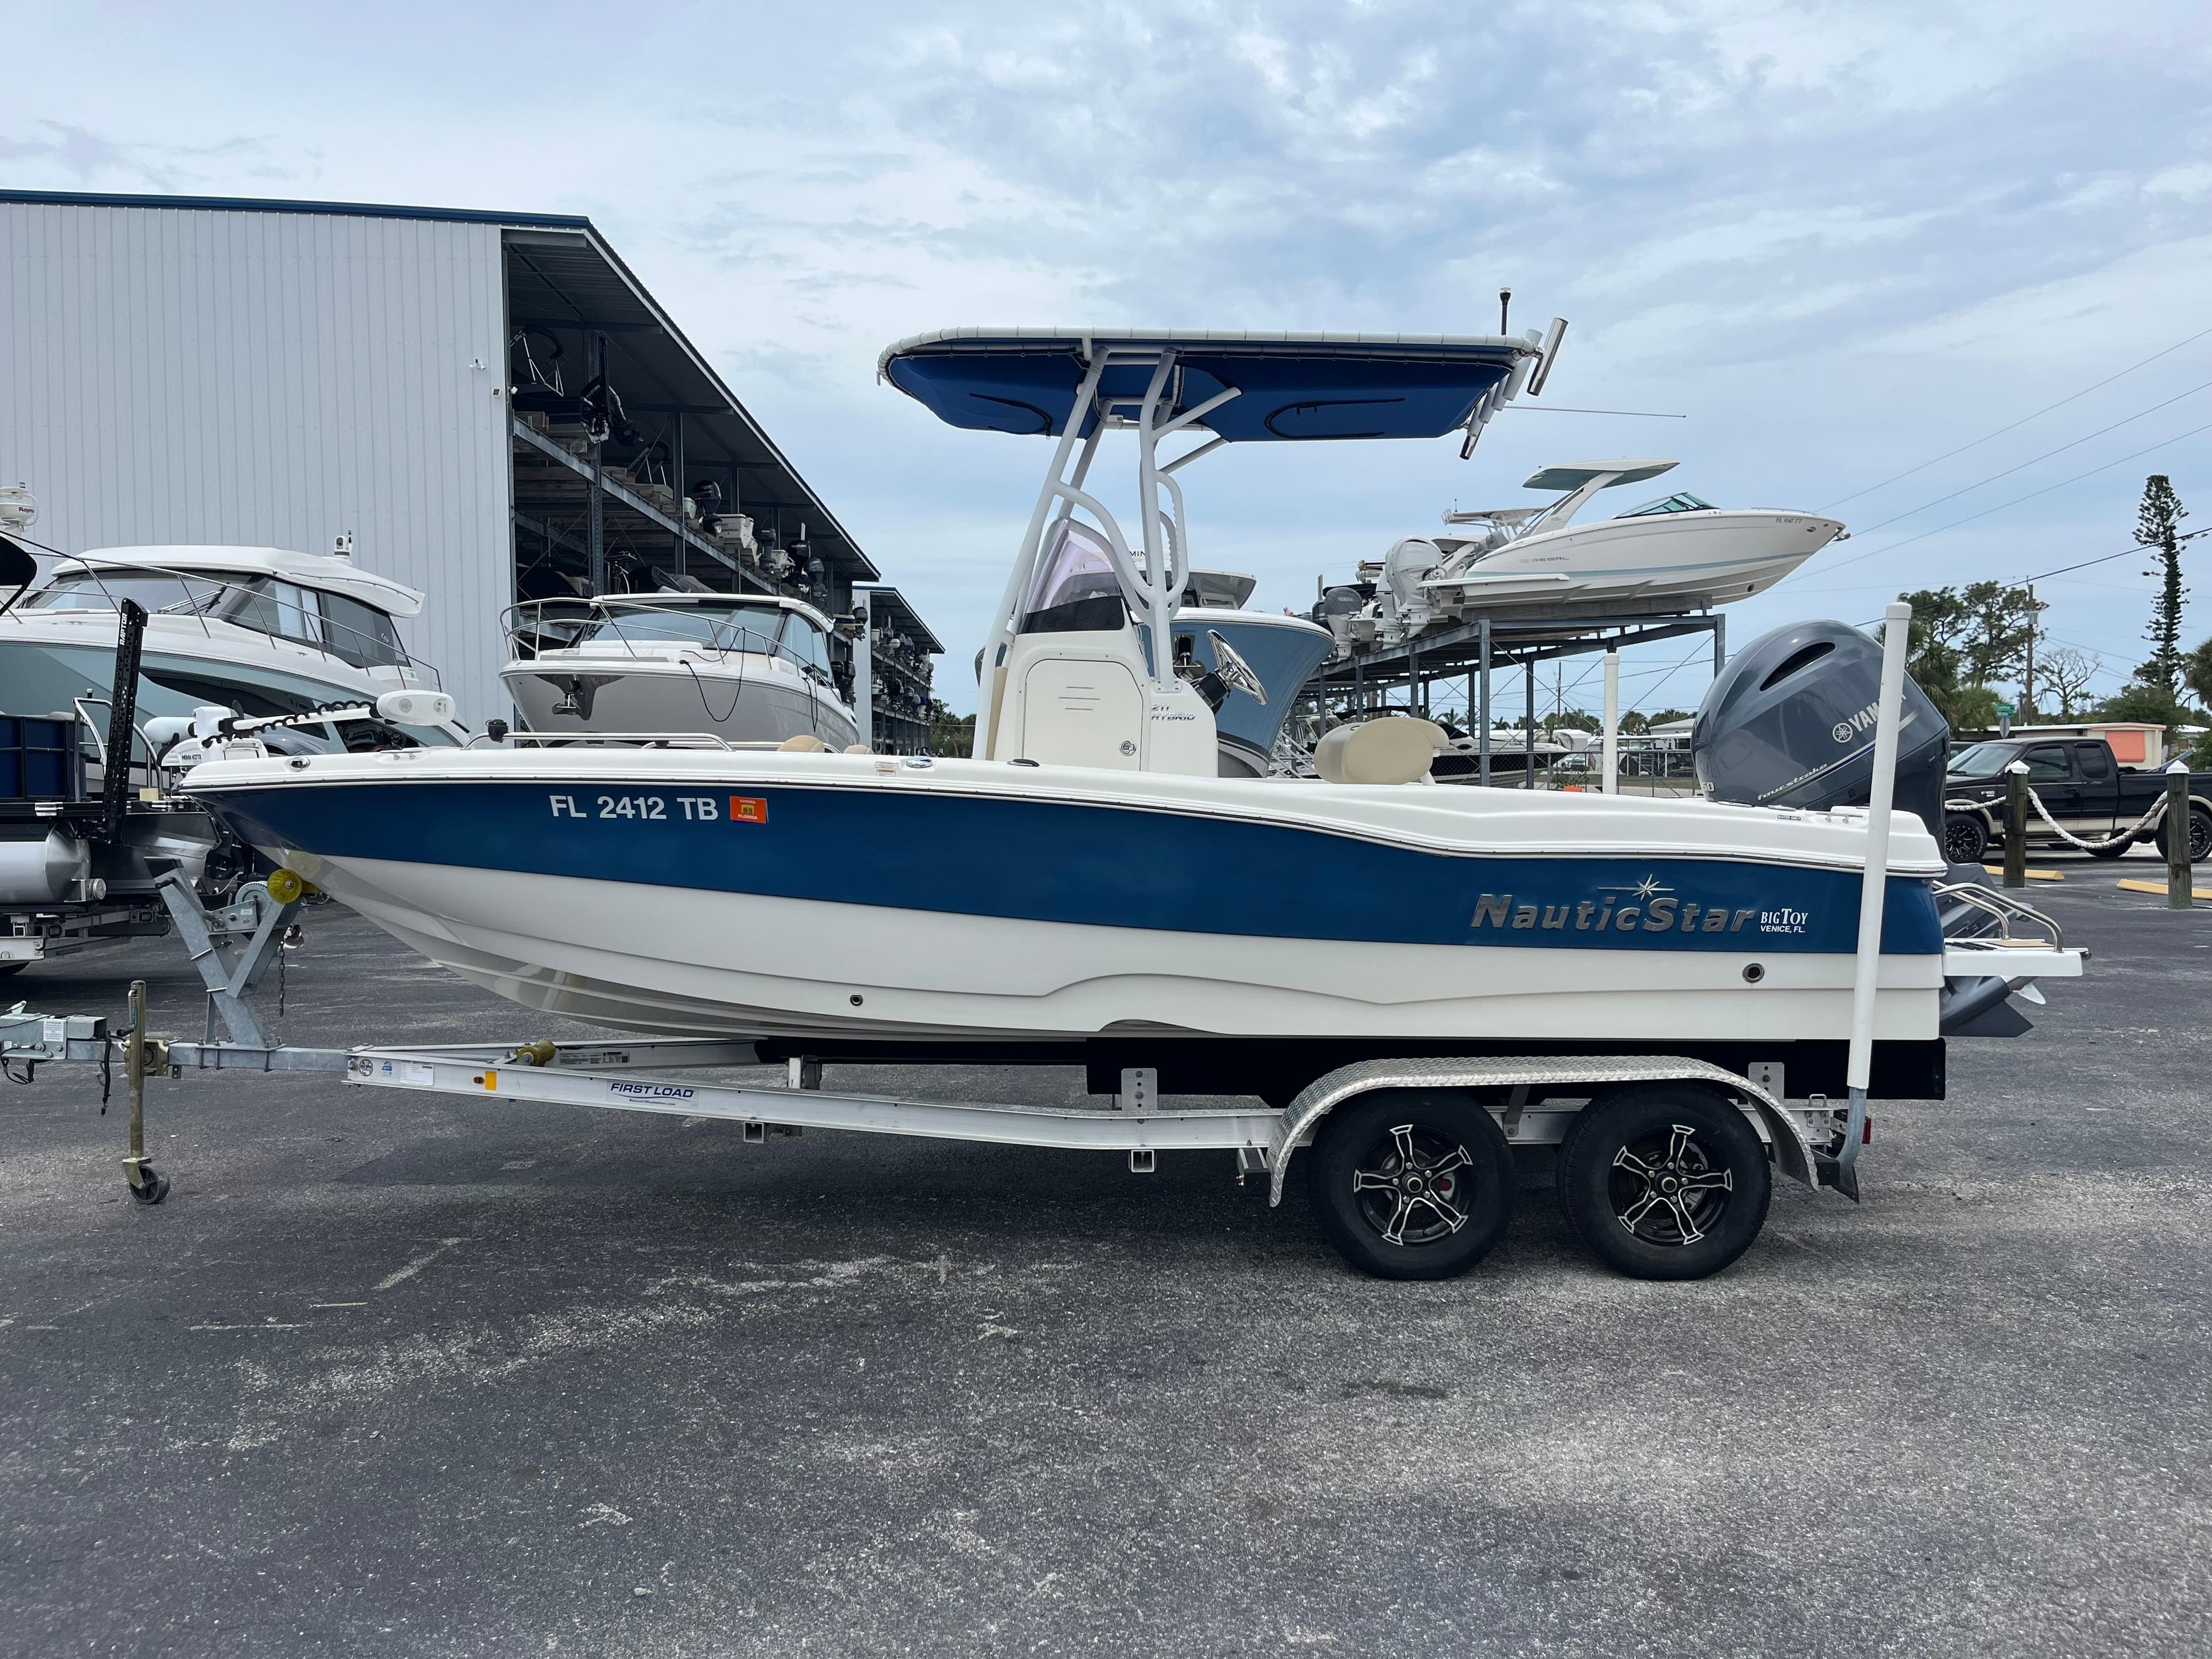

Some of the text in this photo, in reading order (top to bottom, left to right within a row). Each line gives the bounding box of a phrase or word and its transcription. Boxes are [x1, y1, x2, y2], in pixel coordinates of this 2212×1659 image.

[119, 612, 128, 646] RAPTOR
[1152, 703, 1169, 711] 211
[1151, 713, 1196, 721] HYBRID
[549, 795, 719, 820] FL 2412 TB
[1469, 893, 1755, 932] NauticStar
[1760, 925, 1792, 934] VENICE,
[611, 1083, 694, 1098] FIRST LOAD
